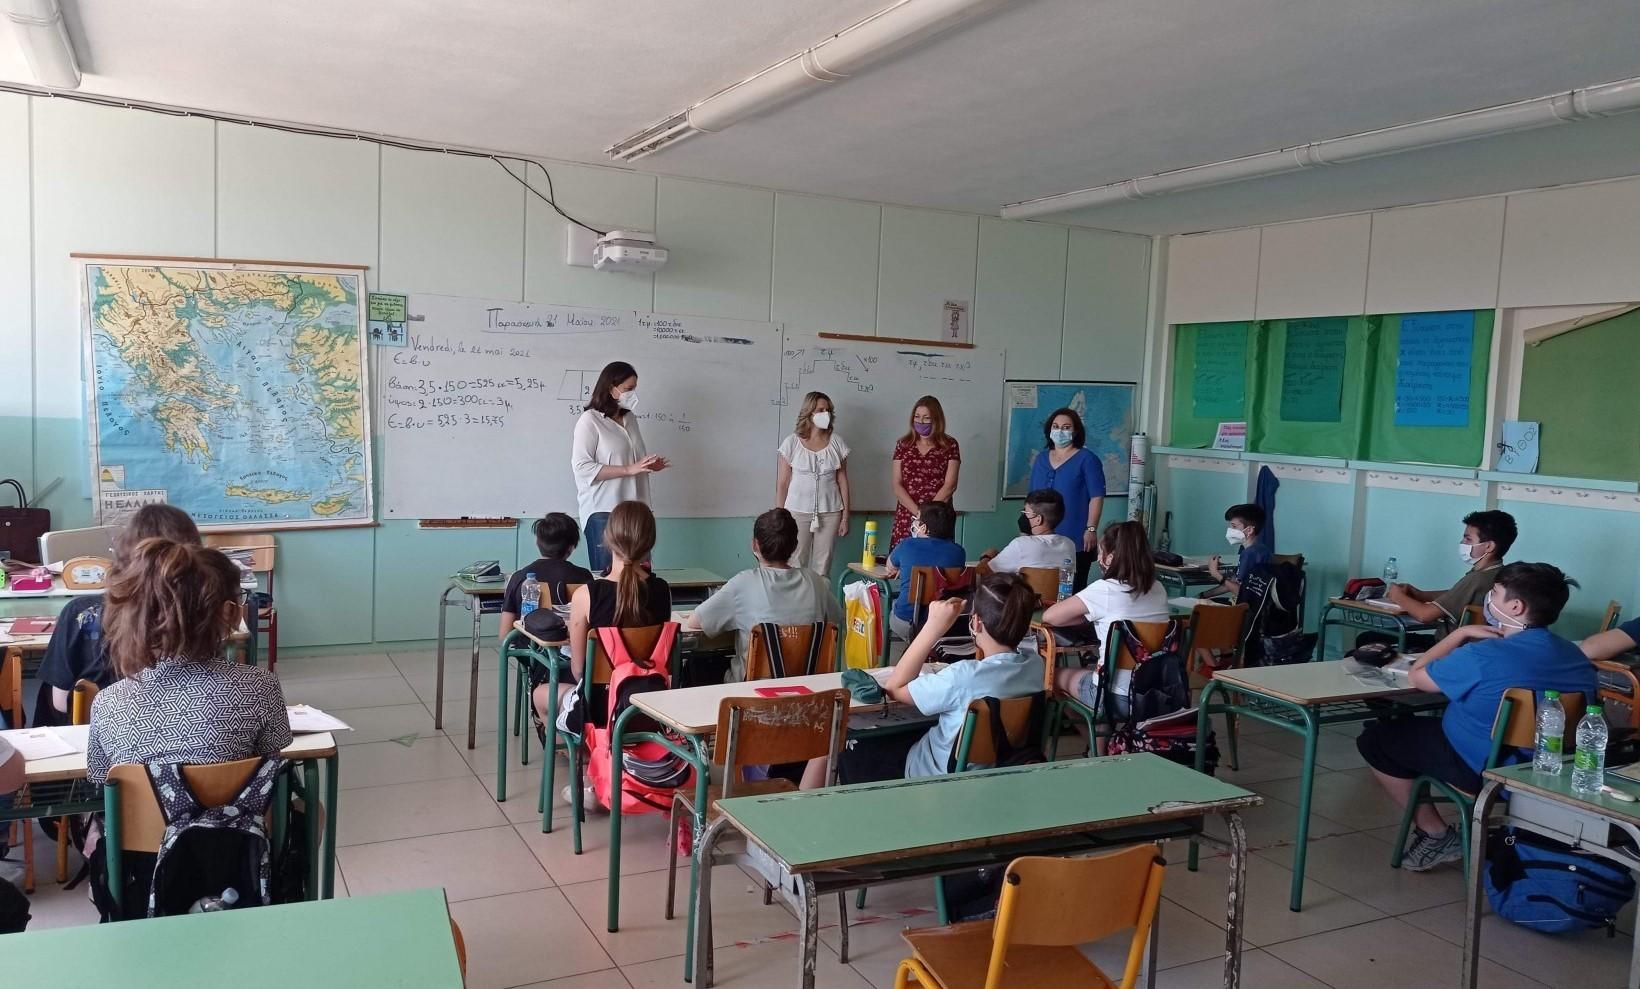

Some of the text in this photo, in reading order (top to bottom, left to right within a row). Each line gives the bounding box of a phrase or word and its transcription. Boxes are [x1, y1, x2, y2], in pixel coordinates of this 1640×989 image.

[485, 346, 503, 357] mai
[509, 348, 532, 358] 2021
[584, 385, 590, 395] 2
